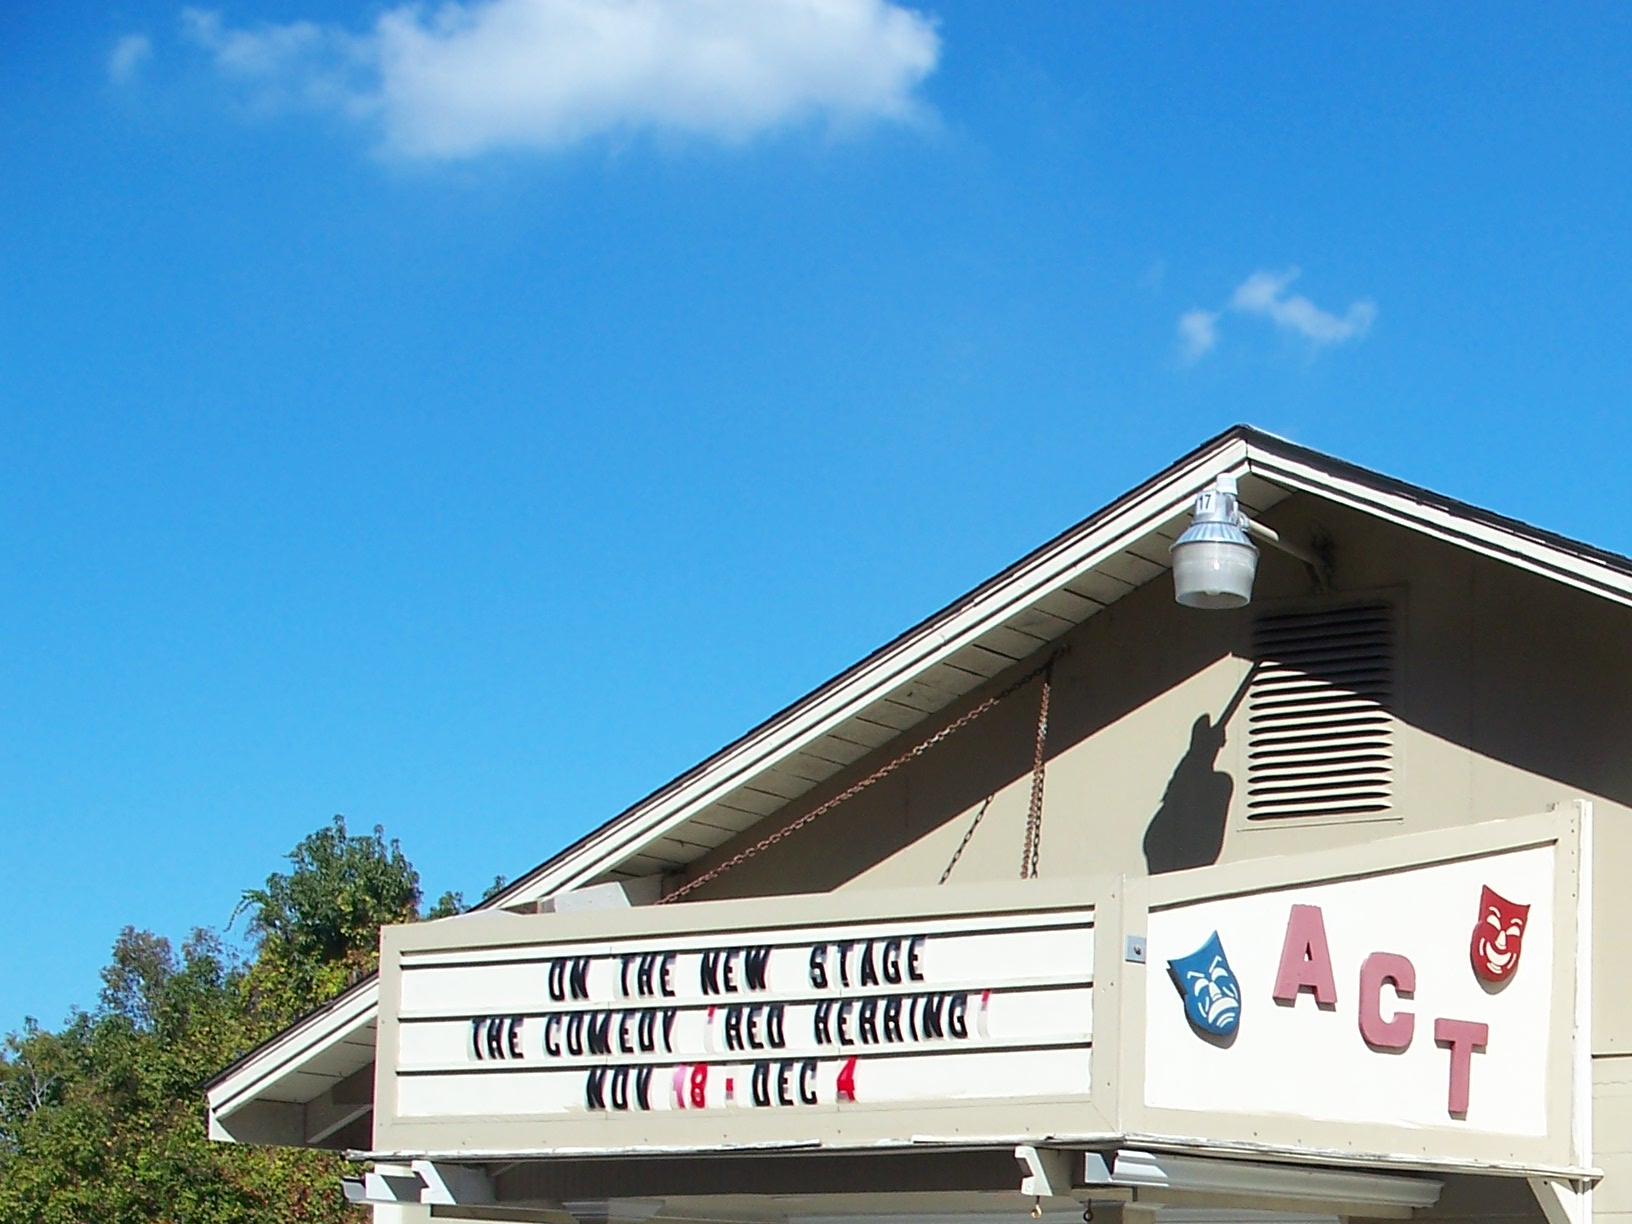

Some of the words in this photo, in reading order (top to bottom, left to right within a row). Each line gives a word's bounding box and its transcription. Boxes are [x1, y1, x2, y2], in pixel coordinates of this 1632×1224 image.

[1200, 494, 1211, 510] 17
[549, 957, 590, 1002] ON
[620, 951, 677, 998] THE
[700, 945, 772, 995] NEW
[809, 934, 927, 988] STAGE
[472, 1016, 524, 1060] THE
[545, 1007, 677, 1056] COMEDY
[586, 1064, 653, 1110] NOV
[673, 1061, 708, 1109] 18
[752, 1059, 818, 1107] DEC
[836, 1053, 858, 1102] 4
